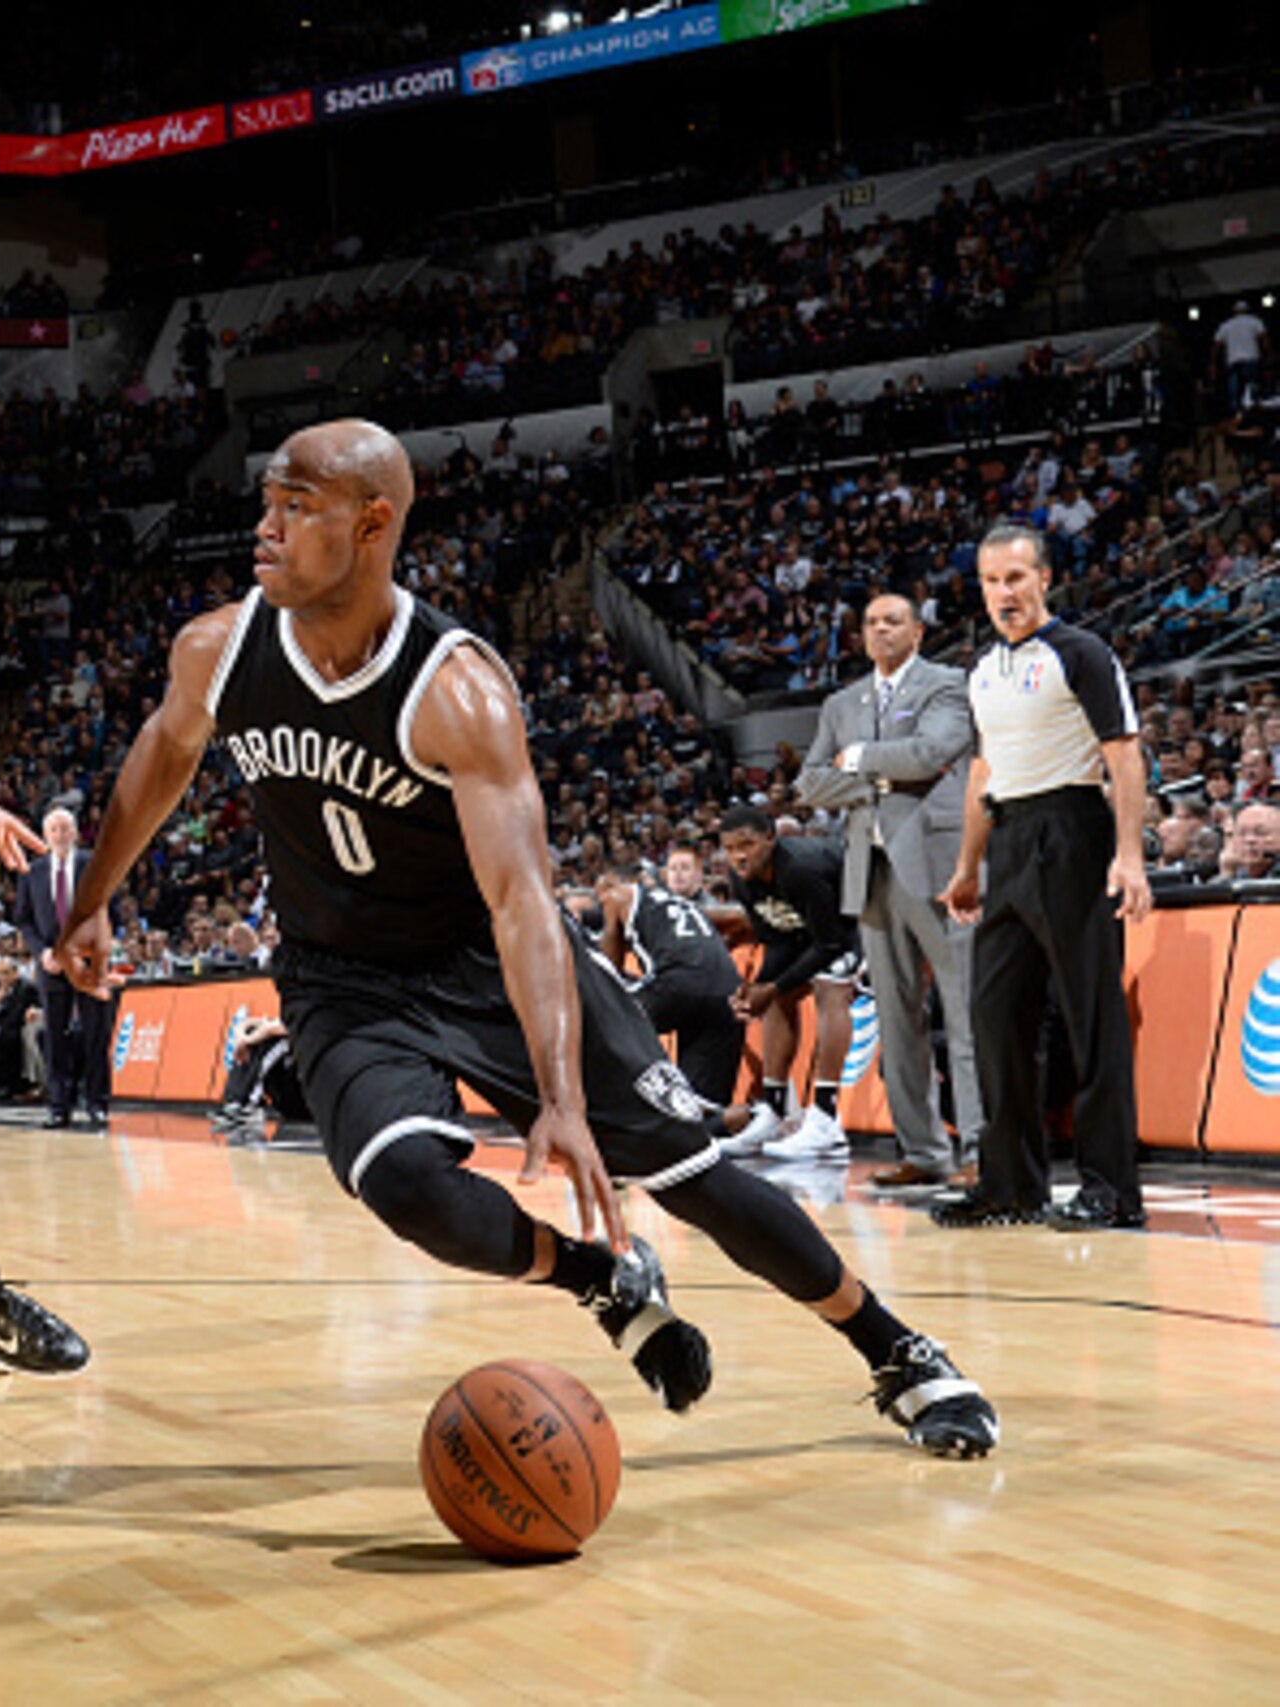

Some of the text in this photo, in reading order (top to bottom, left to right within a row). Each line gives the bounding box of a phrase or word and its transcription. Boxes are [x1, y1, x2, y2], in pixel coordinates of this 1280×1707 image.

[531, 28, 670, 70] CHAMPION
[324, 66, 455, 113] sacu.com
[235, 93, 311, 134] SACU
[80, 114, 214, 169] Pizza Hut
[226, 724, 424, 808] BROOKLYN
[322, 797, 377, 876] 0
[667, 901, 713, 937] 21
